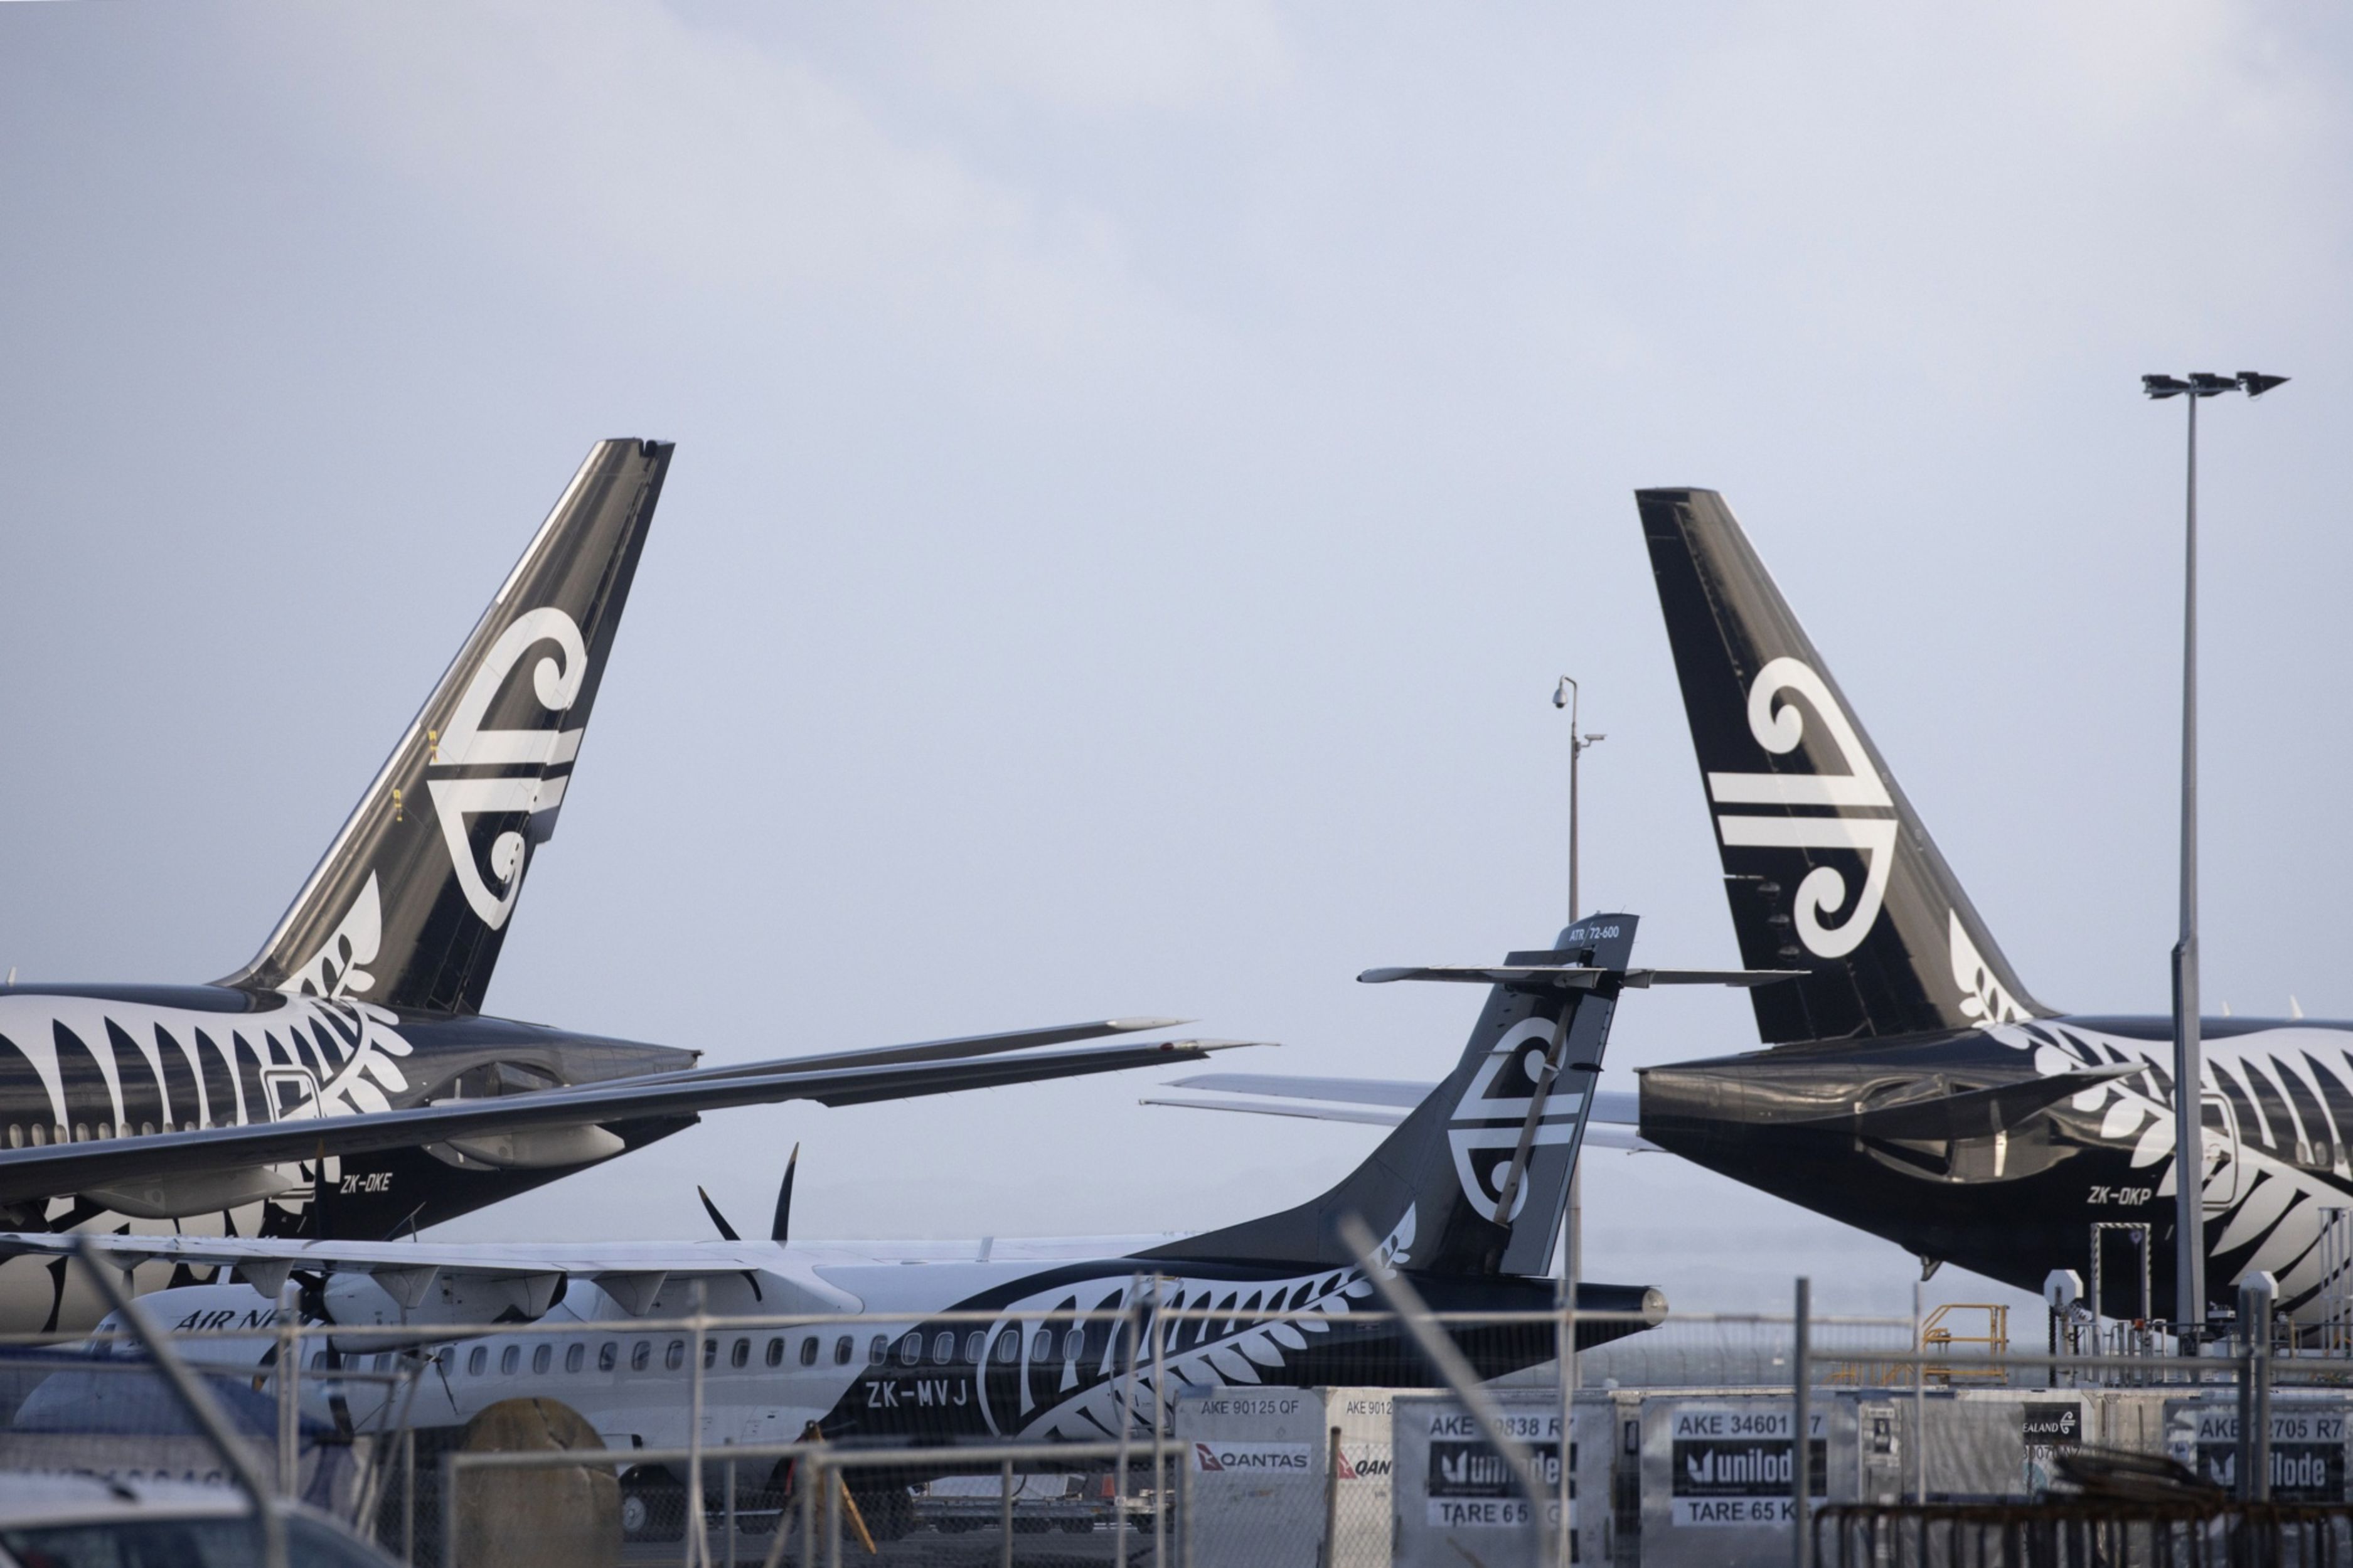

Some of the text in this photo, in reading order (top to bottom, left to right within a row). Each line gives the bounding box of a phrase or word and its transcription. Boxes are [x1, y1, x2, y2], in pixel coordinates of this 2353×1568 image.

[1569, 925, 1619, 942] ATR 72-600
[340, 1172, 393, 1194] ZK-OKE
[2087, 1185, 2152, 1205] ZK-OKP
[172, 1309, 235, 1333] AIR
[865, 1379, 967, 1408] ZK-MVJ
[1202, 1400, 1299, 1414] AKE 90125 QF
[1347, 1401, 1367, 1414] AKE
[1430, 1416, 1473, 1436] AKE
[1483, 1417, 1539, 1436] 9838
[1678, 1416, 1722, 1435] AKE
[1730, 1415, 1788, 1434] 34601
[2200, 1419, 2238, 1437] AKE
[2317, 1419, 2342, 1437] R7
[1220, 1453, 1307, 1468] QANTAS
[1717, 1448, 1793, 1483] unilod
[1441, 1503, 1497, 1523] TARE
[1503, 1503, 1529, 1523] 65
[1689, 1501, 1744, 1522] TARE
[1751, 1501, 1775, 1521] 65
